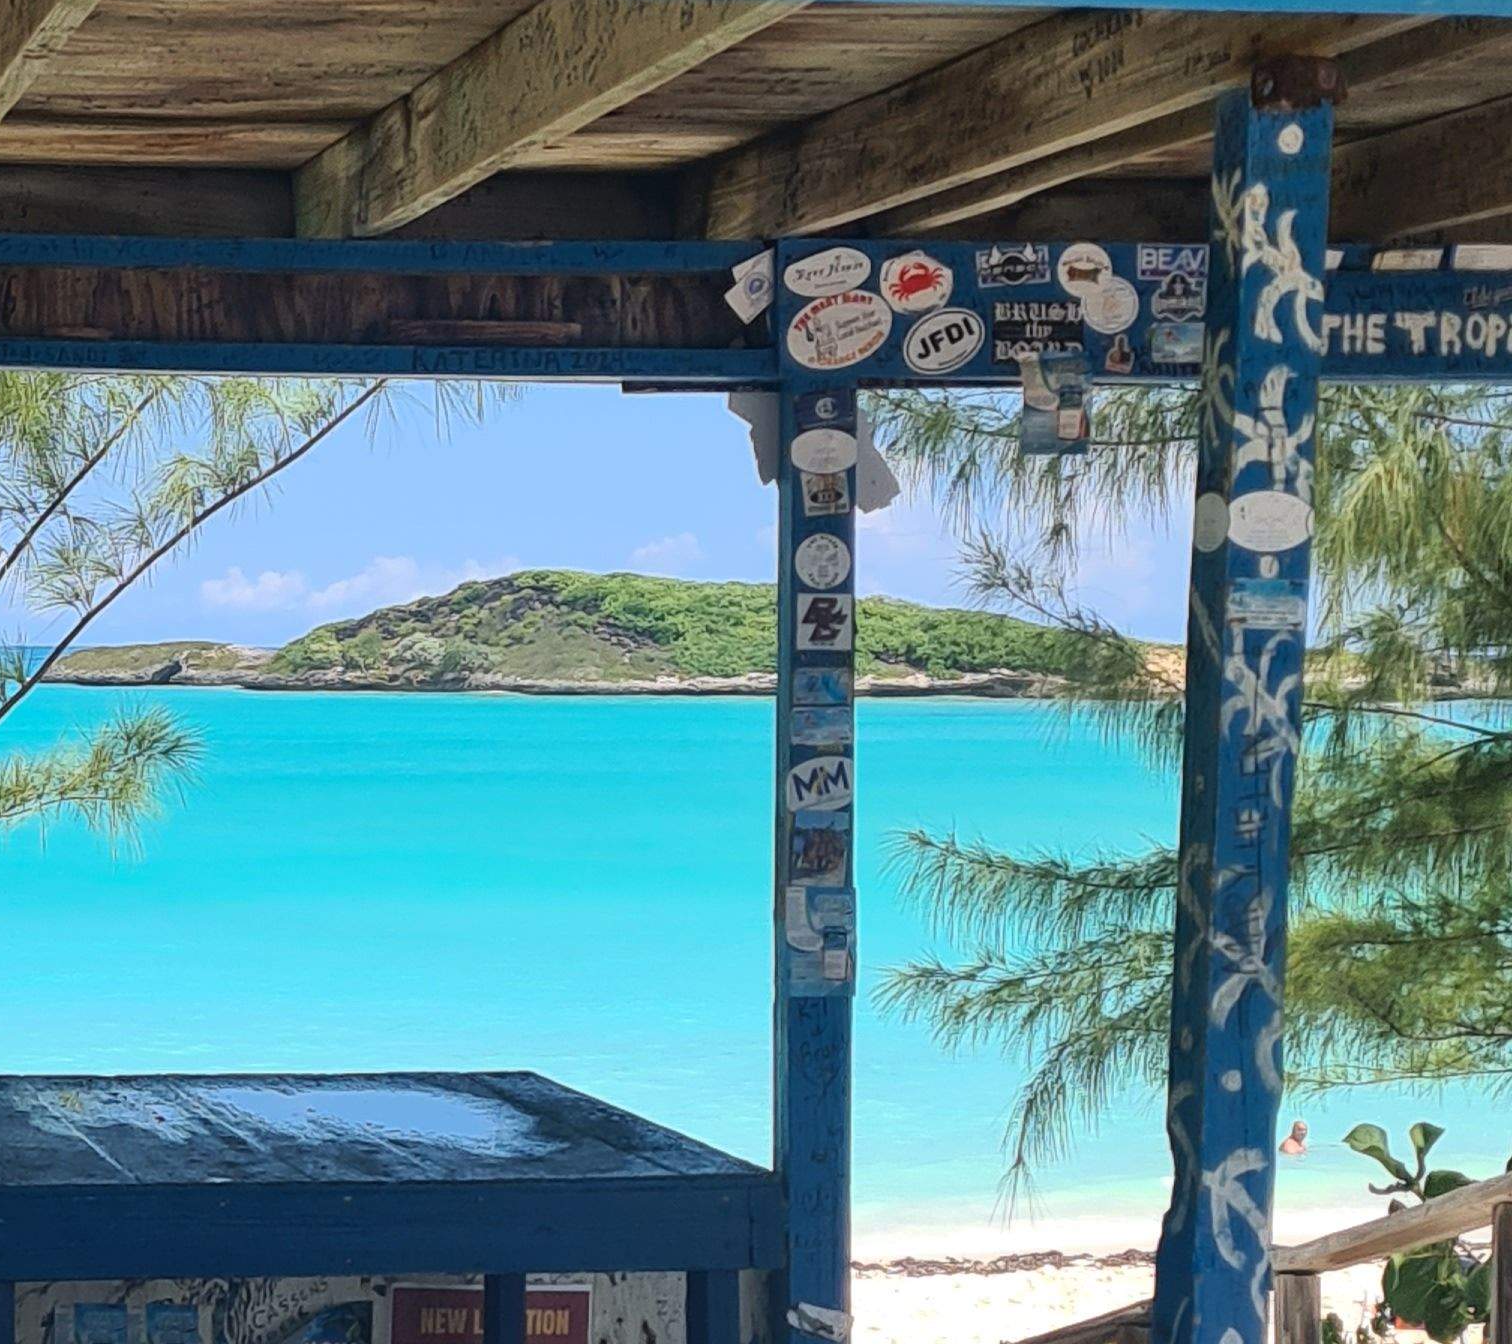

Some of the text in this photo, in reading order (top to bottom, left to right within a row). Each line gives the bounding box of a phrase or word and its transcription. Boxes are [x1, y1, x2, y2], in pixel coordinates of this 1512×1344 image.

[917, 317, 975, 360] JFDI
[420, 1307, 569, 1336] NEW LTION
